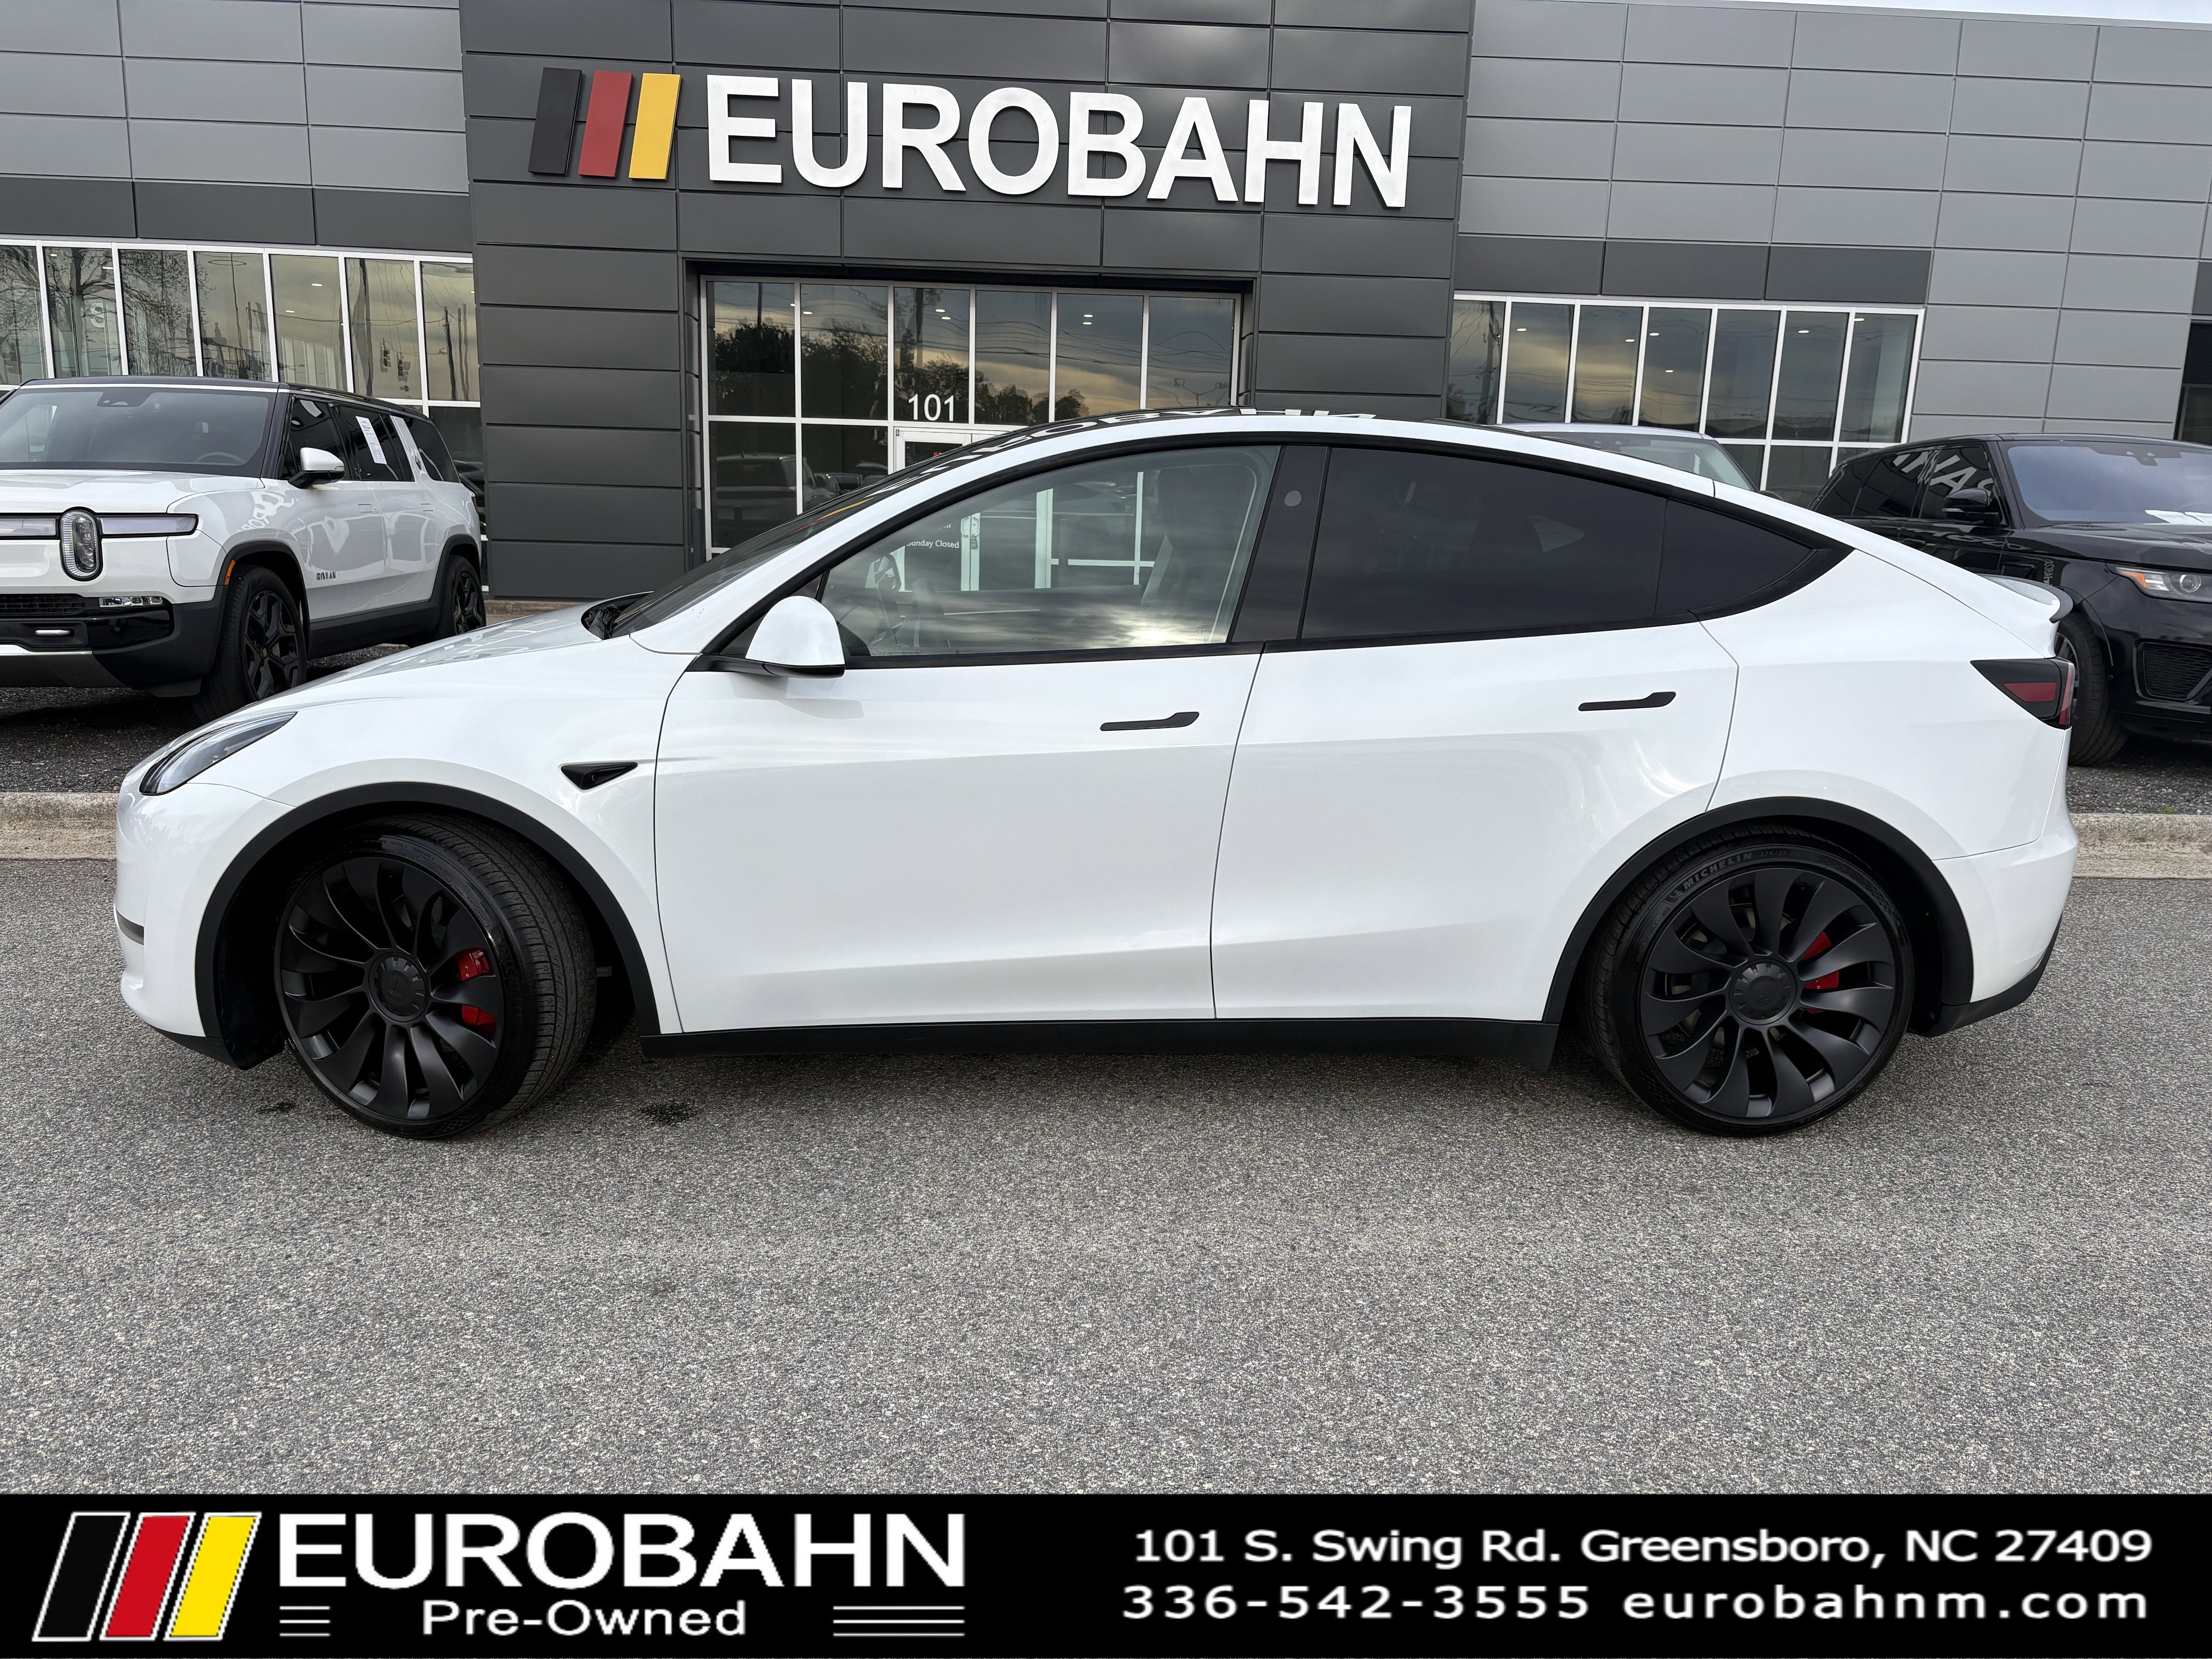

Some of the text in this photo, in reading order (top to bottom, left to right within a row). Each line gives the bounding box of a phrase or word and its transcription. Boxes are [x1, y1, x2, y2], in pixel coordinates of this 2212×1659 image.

[707, 73, 1412, 209] EUROBAHN
[908, 393, 954, 422] 101
[935, 540, 960, 548] Closed
[1683, 852, 1752, 890] MICHELIN
